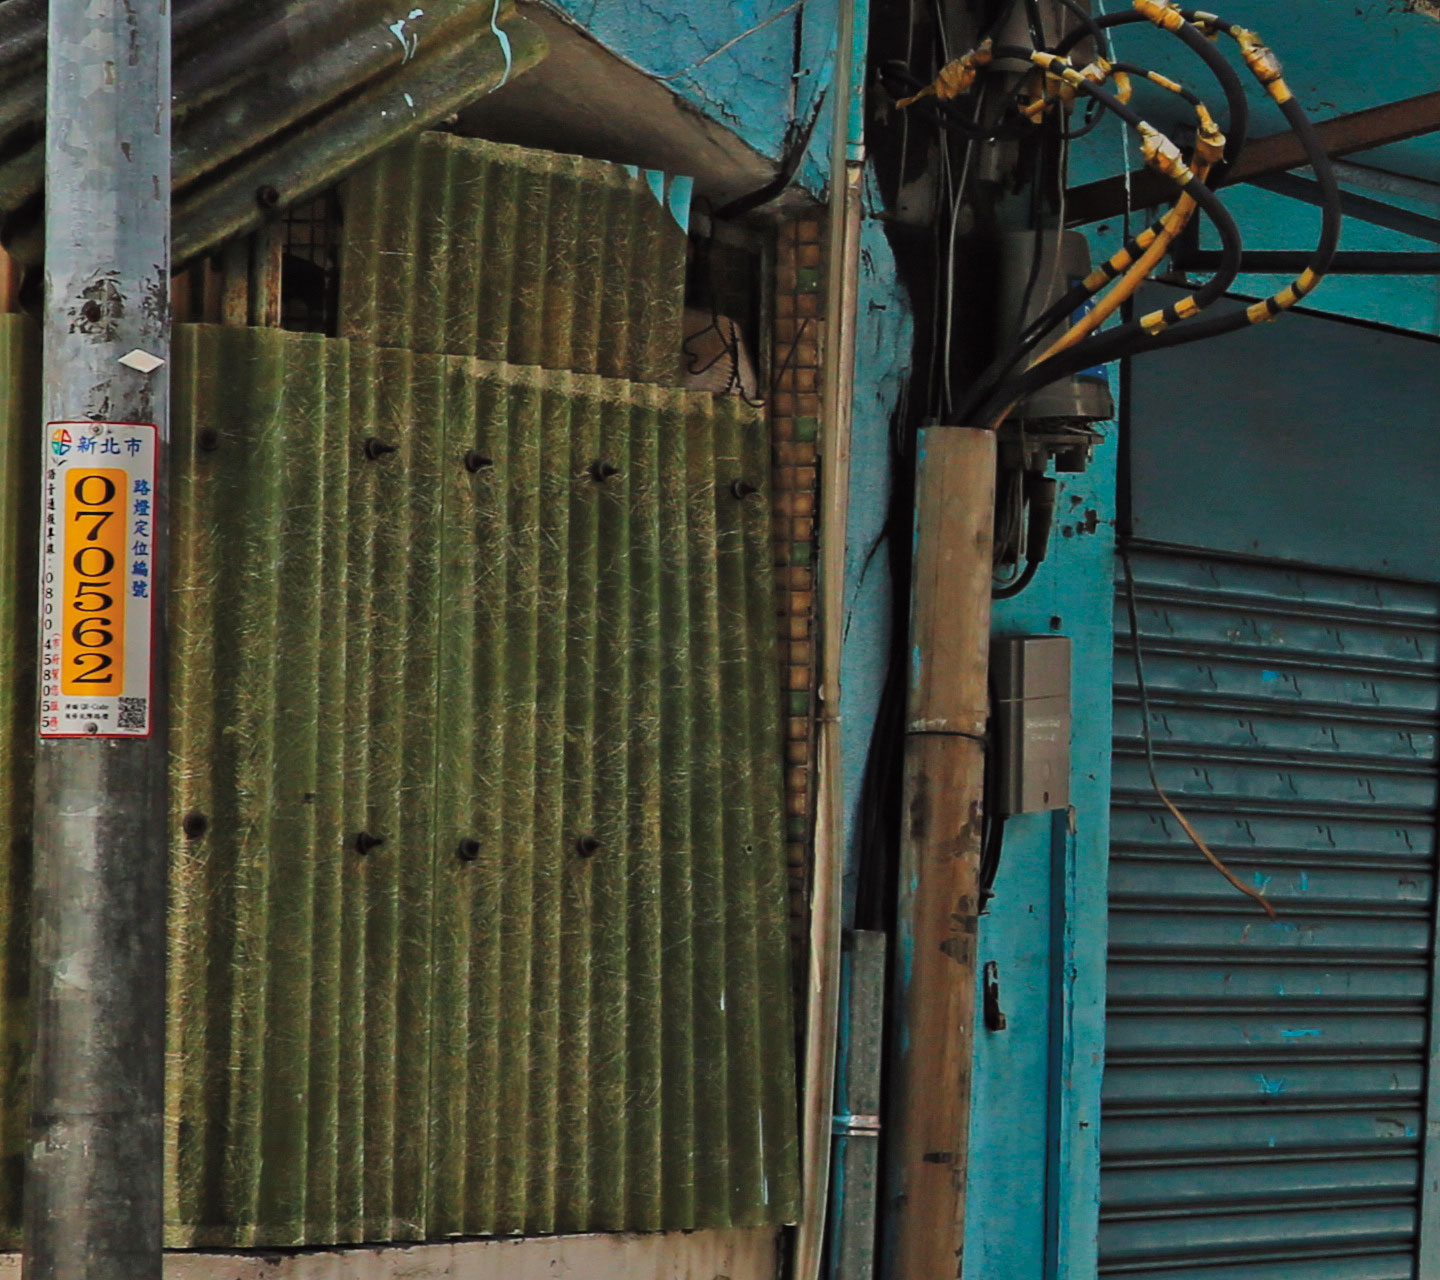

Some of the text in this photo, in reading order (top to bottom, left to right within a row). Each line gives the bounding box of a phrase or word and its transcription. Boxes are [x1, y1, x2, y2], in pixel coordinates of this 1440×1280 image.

[77, 435, 143, 457] 新北市
[71, 475, 116, 684] 070562
[131, 479, 152, 599] 路燈定位編號
